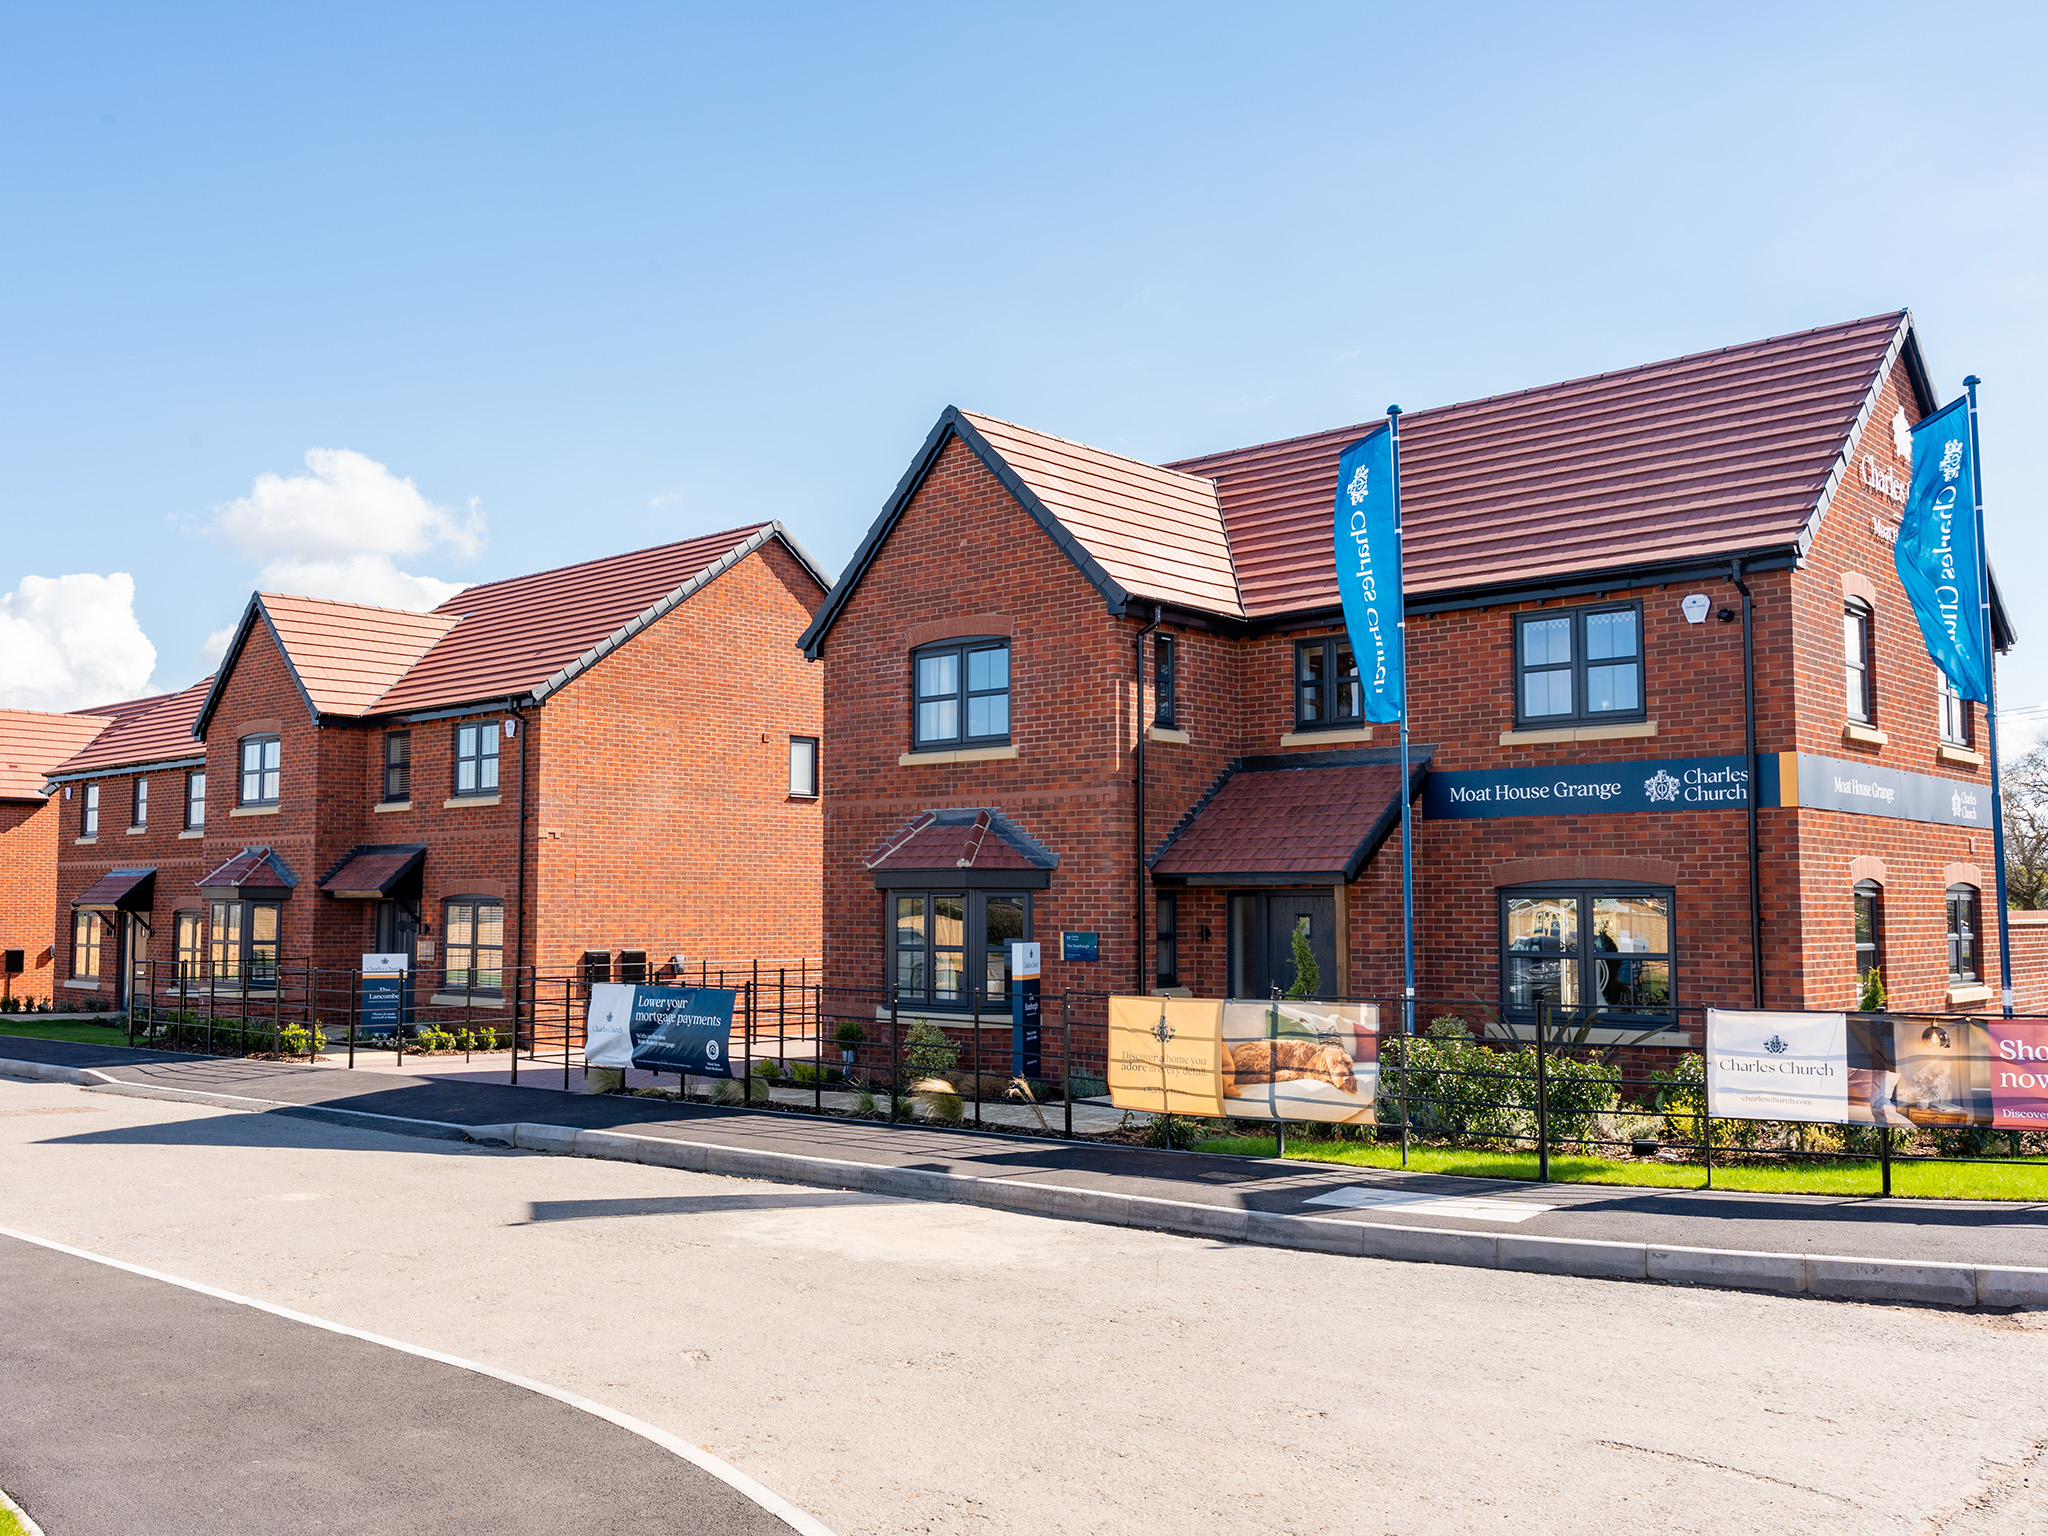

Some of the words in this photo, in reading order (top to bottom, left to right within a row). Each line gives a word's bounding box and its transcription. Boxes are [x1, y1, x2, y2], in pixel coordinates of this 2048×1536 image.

[1862, 454, 1905, 503] Charles
[1684, 766, 1749, 785] Charles
[1450, 786, 1492, 803] Moat
[1495, 783, 1550, 801] House
[1553, 781, 1622, 800] Grange
[1684, 785, 1748, 802] Church
[1834, 776, 1852, 793] Moat
[1852, 779, 1872, 796] House
[1872, 782, 1895, 804] Grange
[1960, 790, 1977, 806] Charles
[1961, 805, 1977, 820] Church
[638, 995, 666, 1008] Lower
[666, 999, 688, 1011] your
[636, 1012, 676, 1025] mortgage
[677, 1014, 722, 1027] payments
[1122, 1050, 1158, 1062] Discover
[1166, 1054, 1188, 1064] home
[1190, 1057, 1207, 1067] you
[1999, 1039, 2048, 1061] Sho
[1121, 1062, 1148, 1072] adore
[1720, 1058, 1776, 1073] Charles
[1779, 1061, 1834, 1076] Church
[1741, 1095, 1813, 1106] charleschurch.com
[2002, 1108, 2048, 1119] Discove
